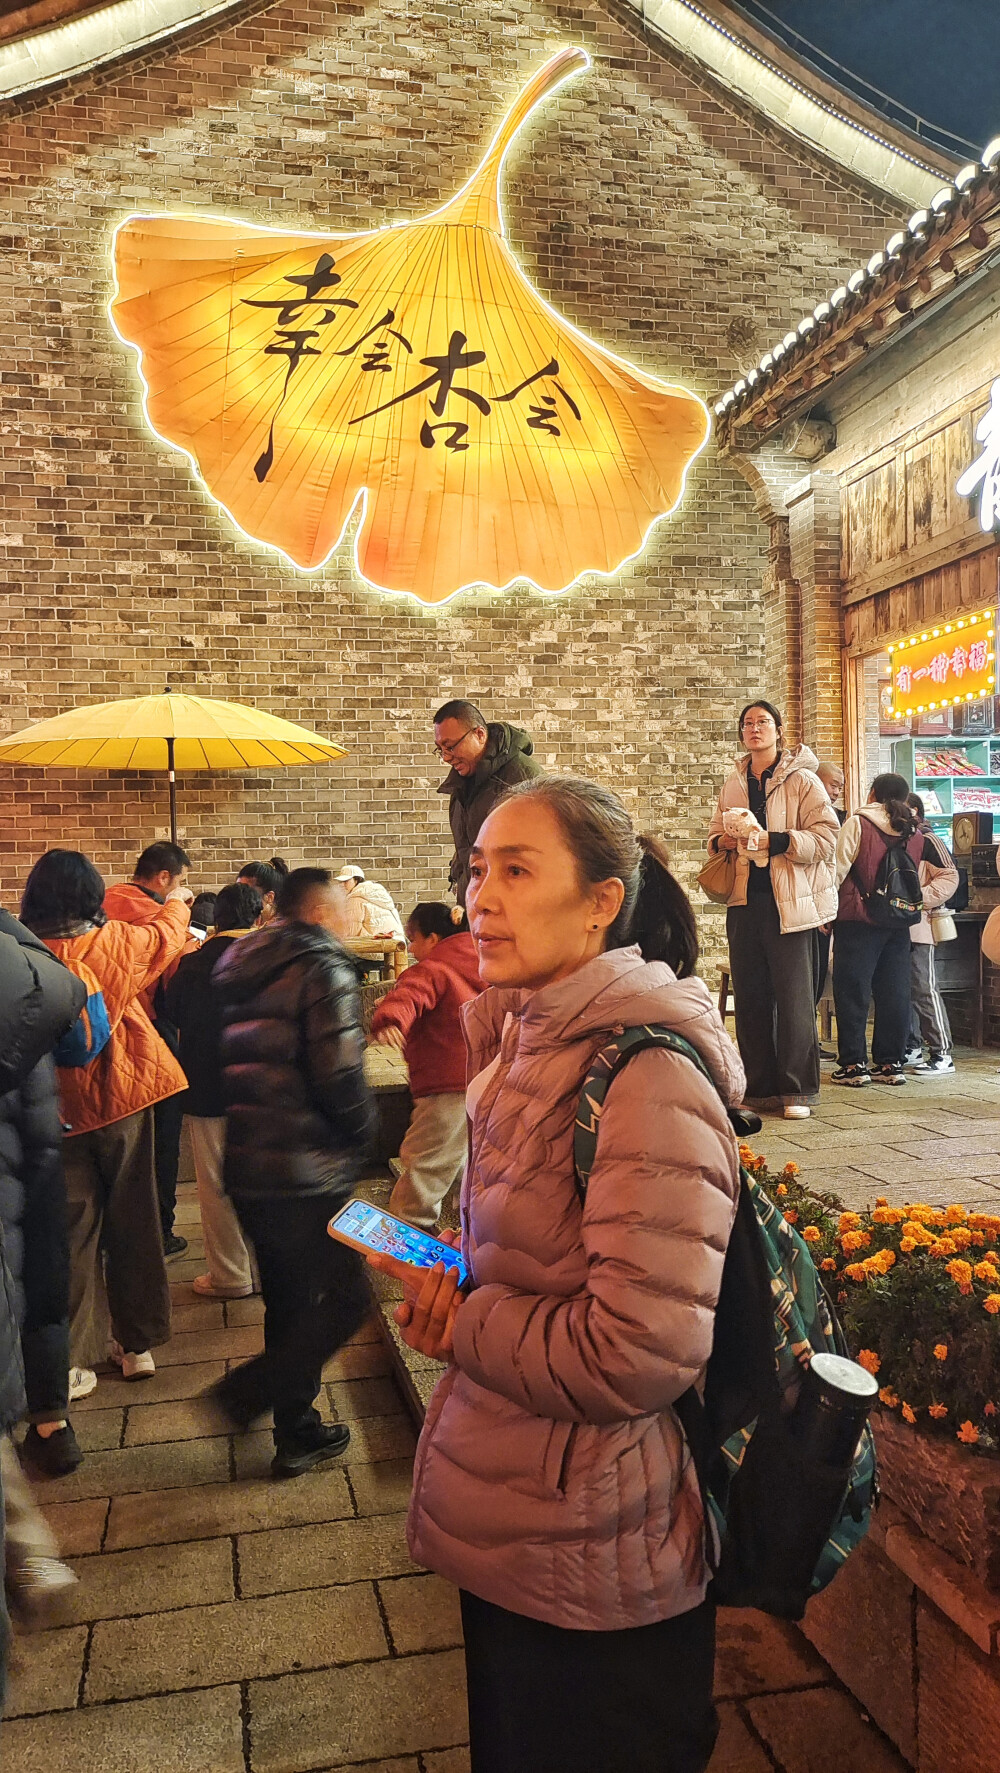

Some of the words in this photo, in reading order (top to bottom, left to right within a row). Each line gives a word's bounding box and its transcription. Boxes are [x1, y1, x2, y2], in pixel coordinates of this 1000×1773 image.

[896, 640, 987, 693] 有一种幸福
